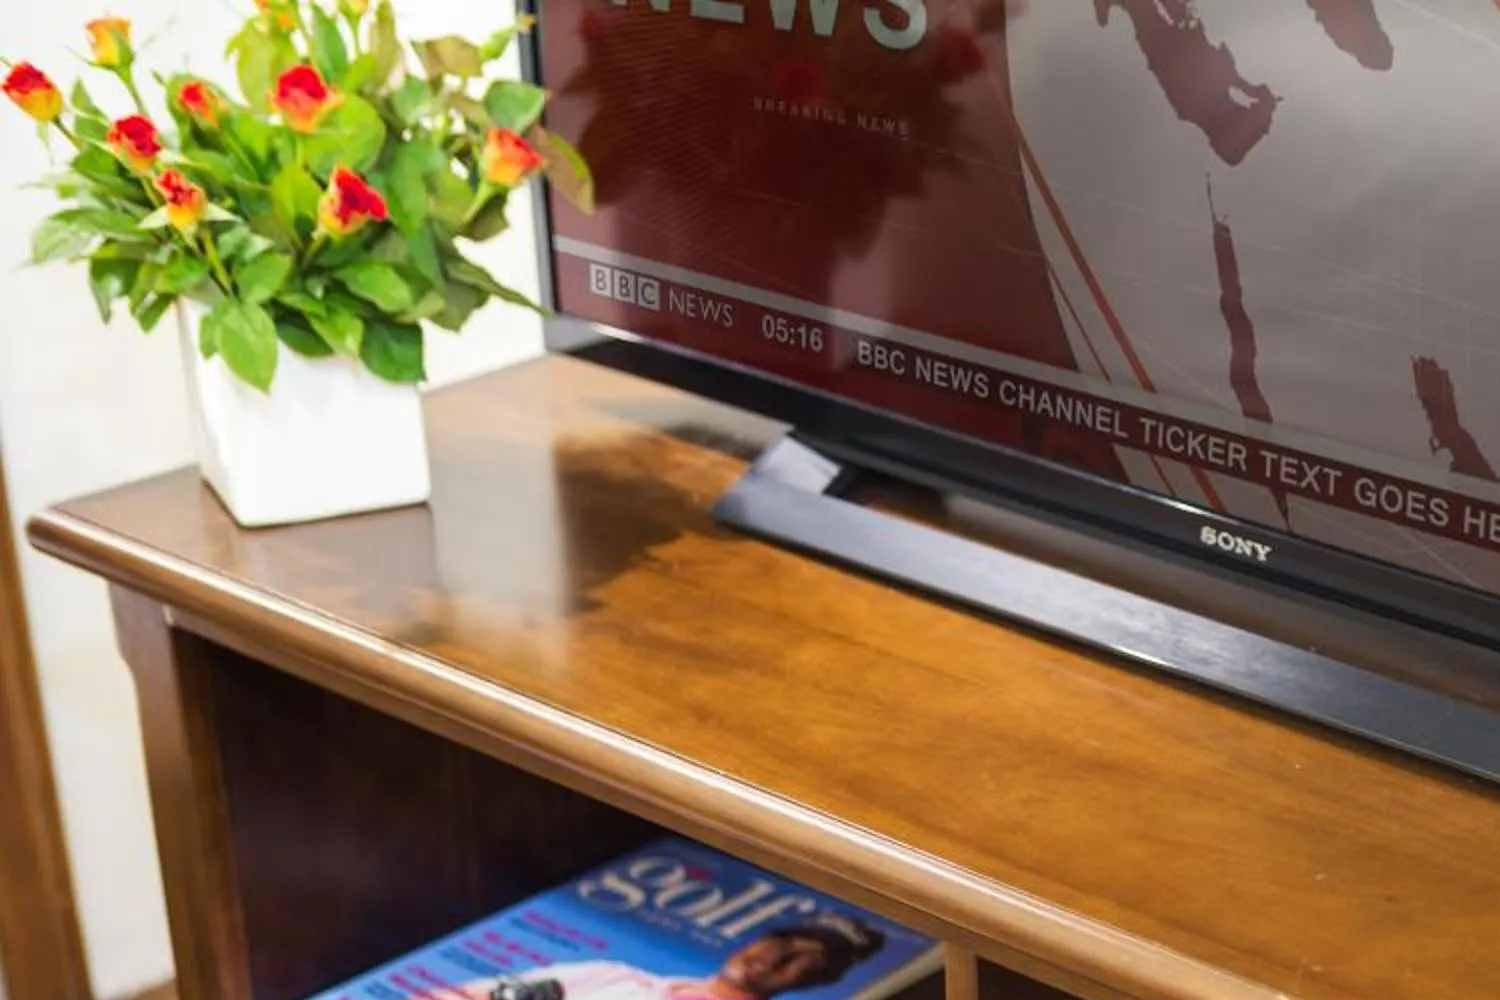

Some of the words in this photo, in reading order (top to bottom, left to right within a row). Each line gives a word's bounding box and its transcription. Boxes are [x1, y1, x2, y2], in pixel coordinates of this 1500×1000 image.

[612, 0, 927, 50] WS
[589, 263, 661, 312] BBC
[668, 286, 734, 328] NEWS
[761, 314, 824, 353] 05:16
[857, 340, 906, 376] BBC
[915, 356, 990, 399] NEWS
[999, 380, 1130, 440] CHANNEL
[1139, 416, 1248, 472] TICKER
[1259, 449, 1343, 497] TEXT
[1354, 477, 1450, 527] GOES
[1200, 525, 1272, 562] SONY
[577, 856, 817, 939] golf
